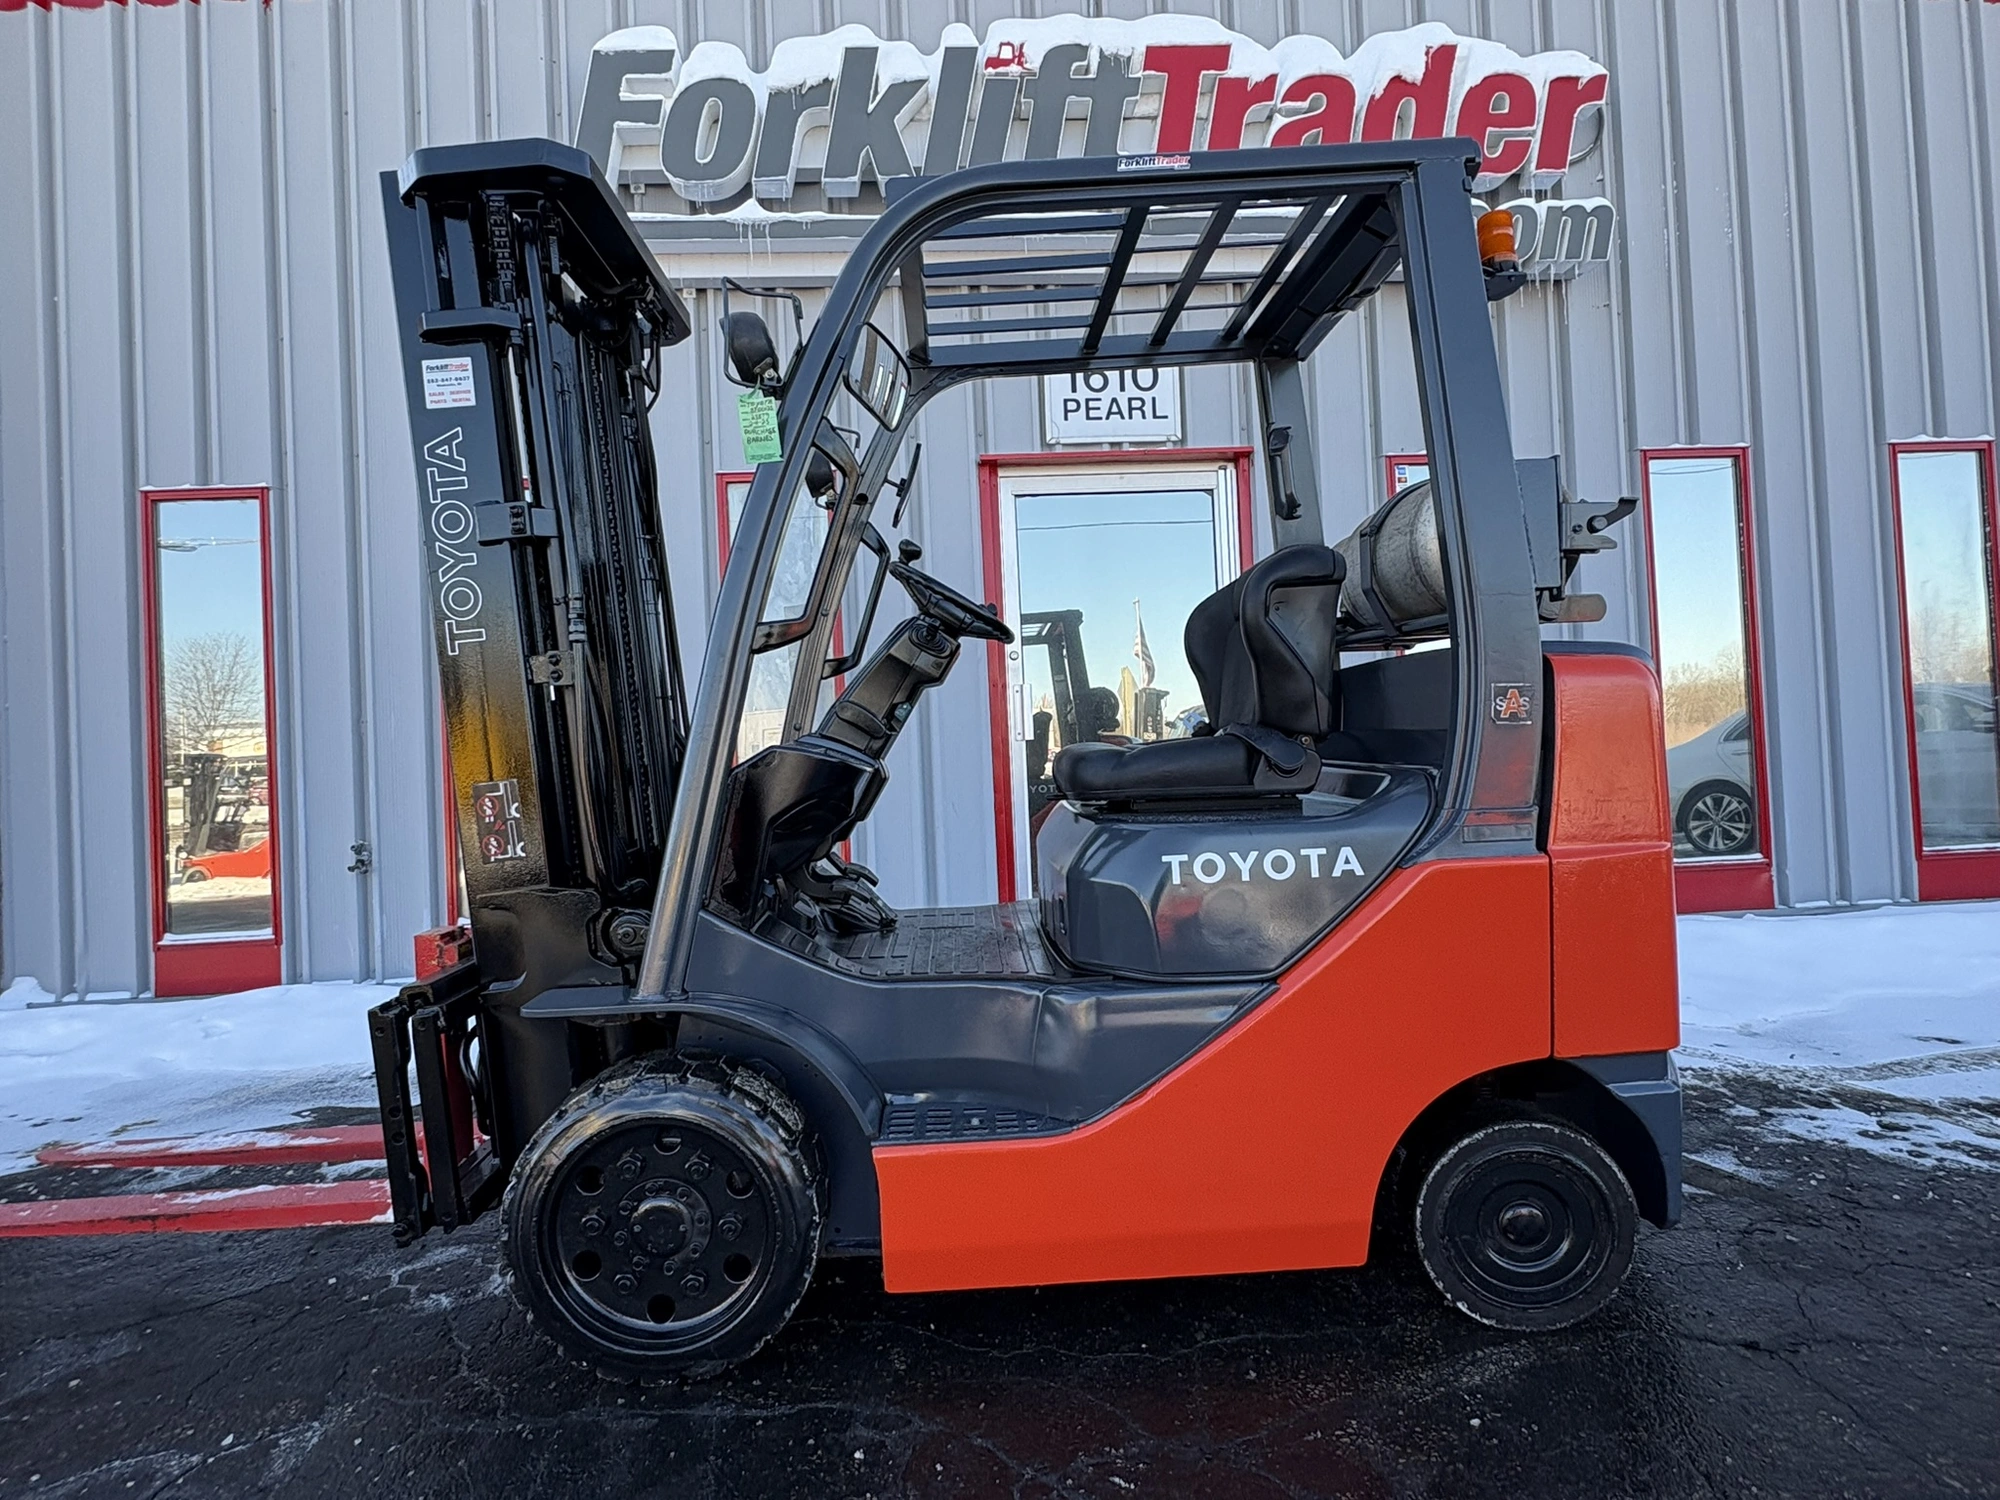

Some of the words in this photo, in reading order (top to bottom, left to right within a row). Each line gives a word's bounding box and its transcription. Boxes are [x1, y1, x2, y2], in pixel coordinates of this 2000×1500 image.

[1119, 156, 1190, 168] ForkliftTrader
[1063, 396, 1169, 421] PEARL
[424, 426, 486, 655] TOYOTA
[1161, 846, 1365, 885] TOYOTA
